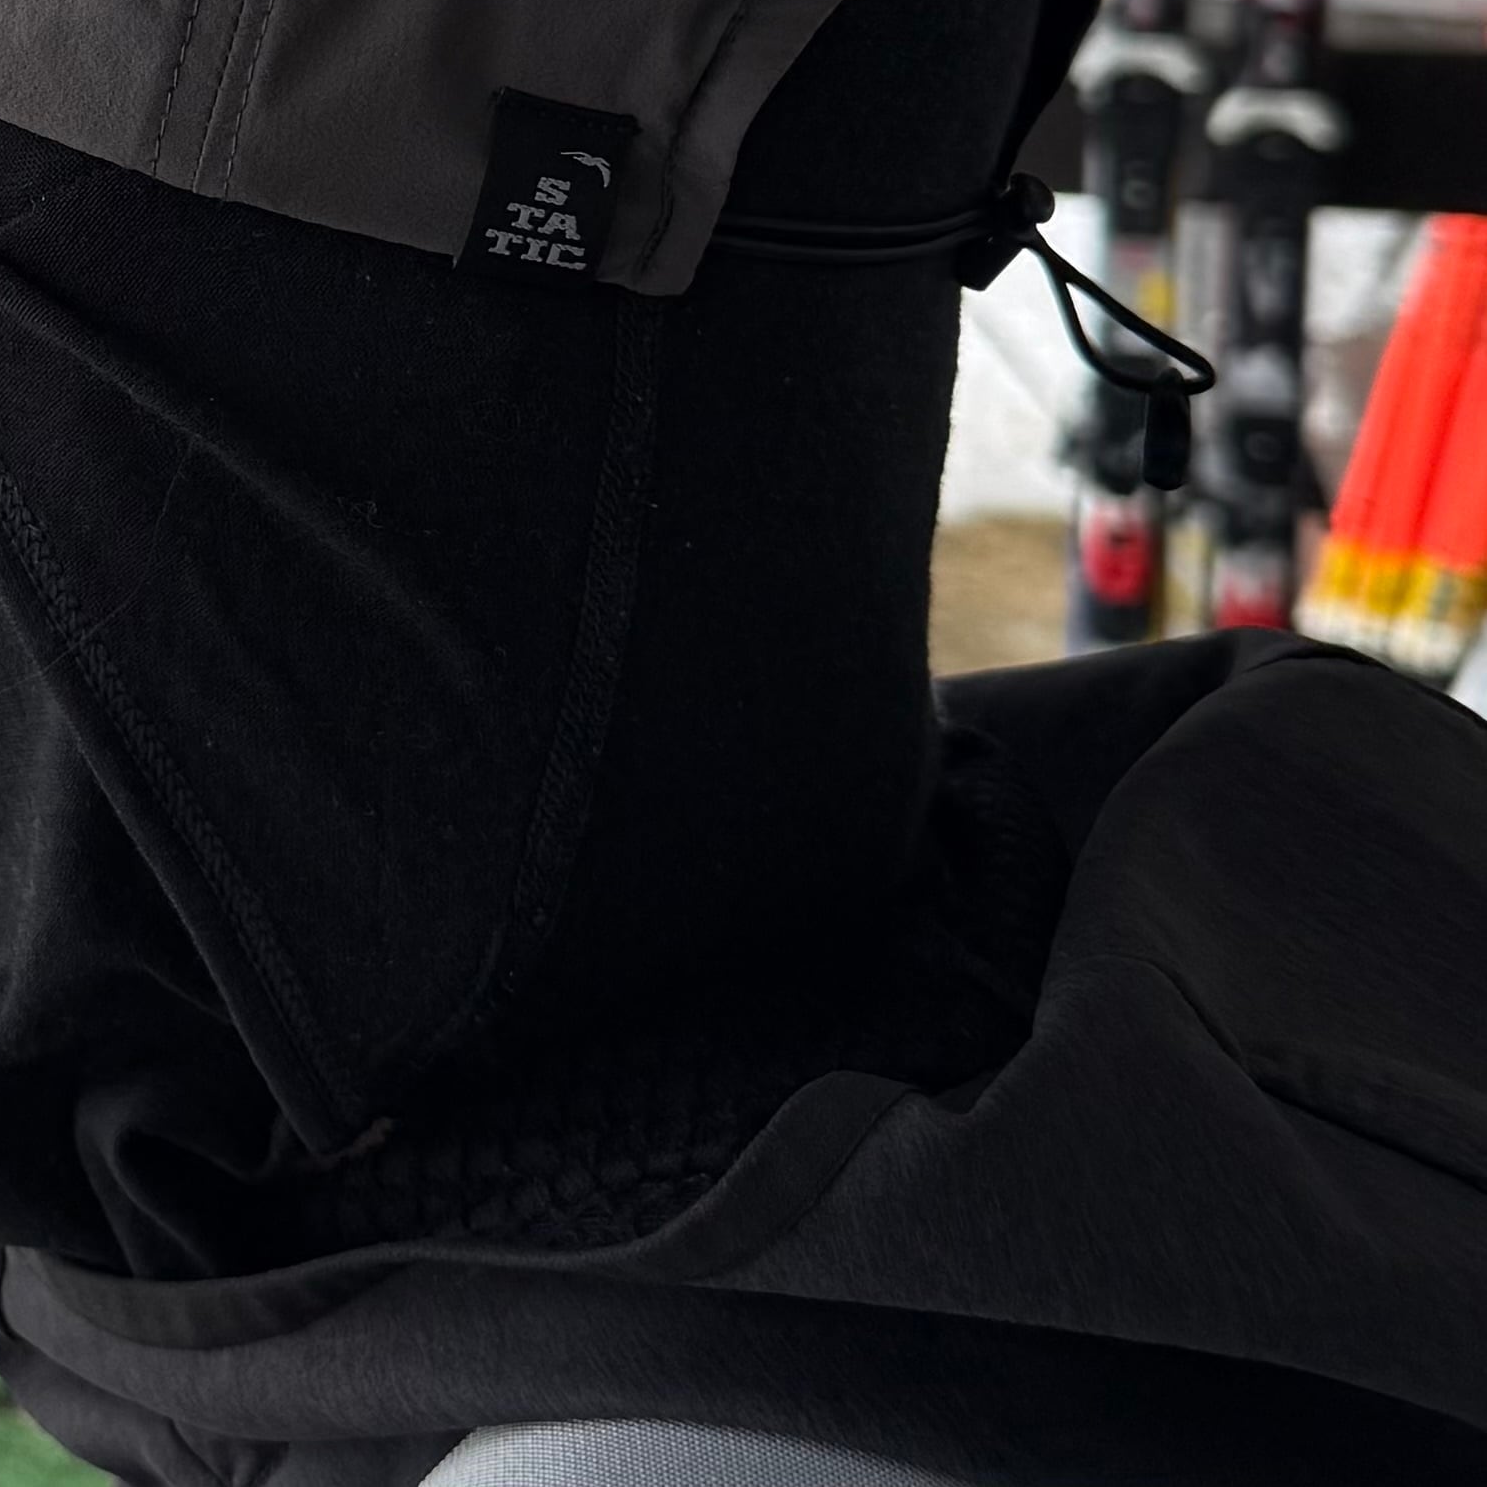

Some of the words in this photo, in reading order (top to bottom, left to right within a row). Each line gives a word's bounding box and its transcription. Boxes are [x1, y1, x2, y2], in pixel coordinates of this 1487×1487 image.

[534, 176, 571, 206] S
[506, 202, 581, 240] TA
[485, 228, 587, 270] TIC
